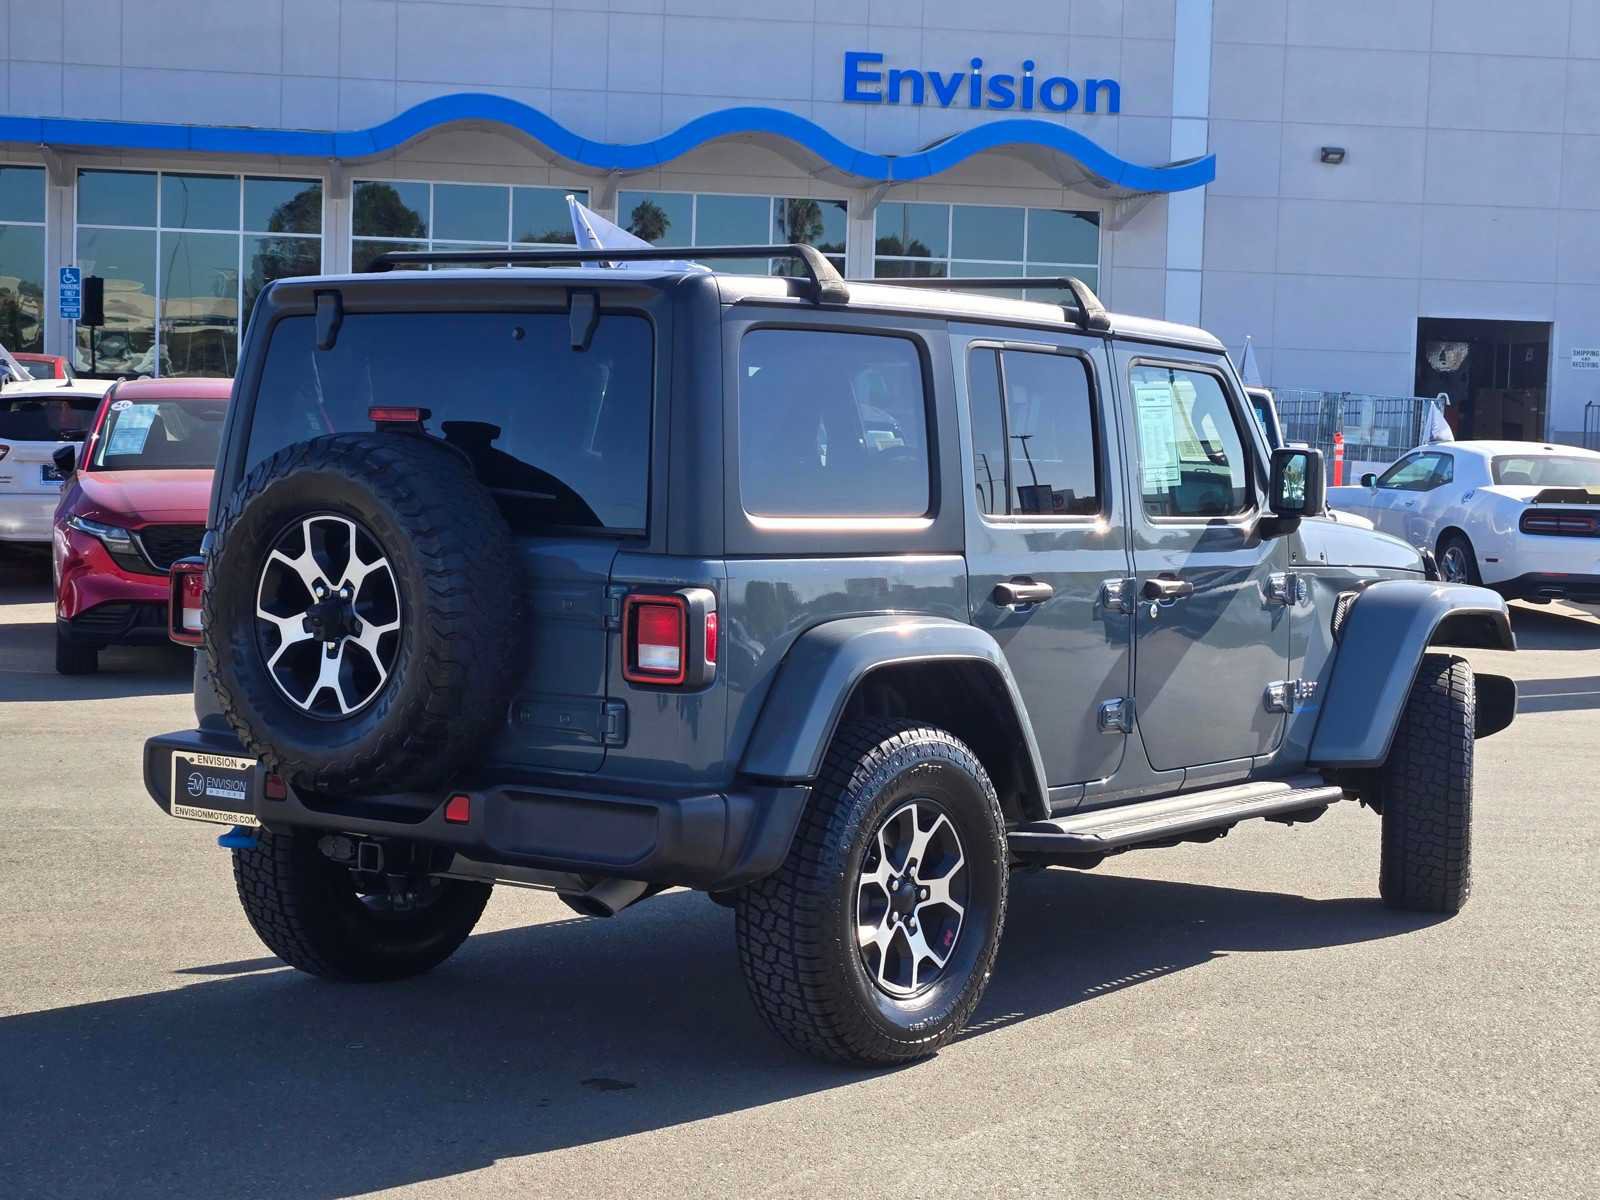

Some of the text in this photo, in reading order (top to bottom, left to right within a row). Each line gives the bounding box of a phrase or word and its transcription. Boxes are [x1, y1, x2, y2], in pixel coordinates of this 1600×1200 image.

[844, 51, 1121, 113] Envision
[197, 755, 238, 768] ENVISION
[206, 776, 247, 792] ENVISION
[175, 806, 257, 825] ENVISIONMOTORS.COM
